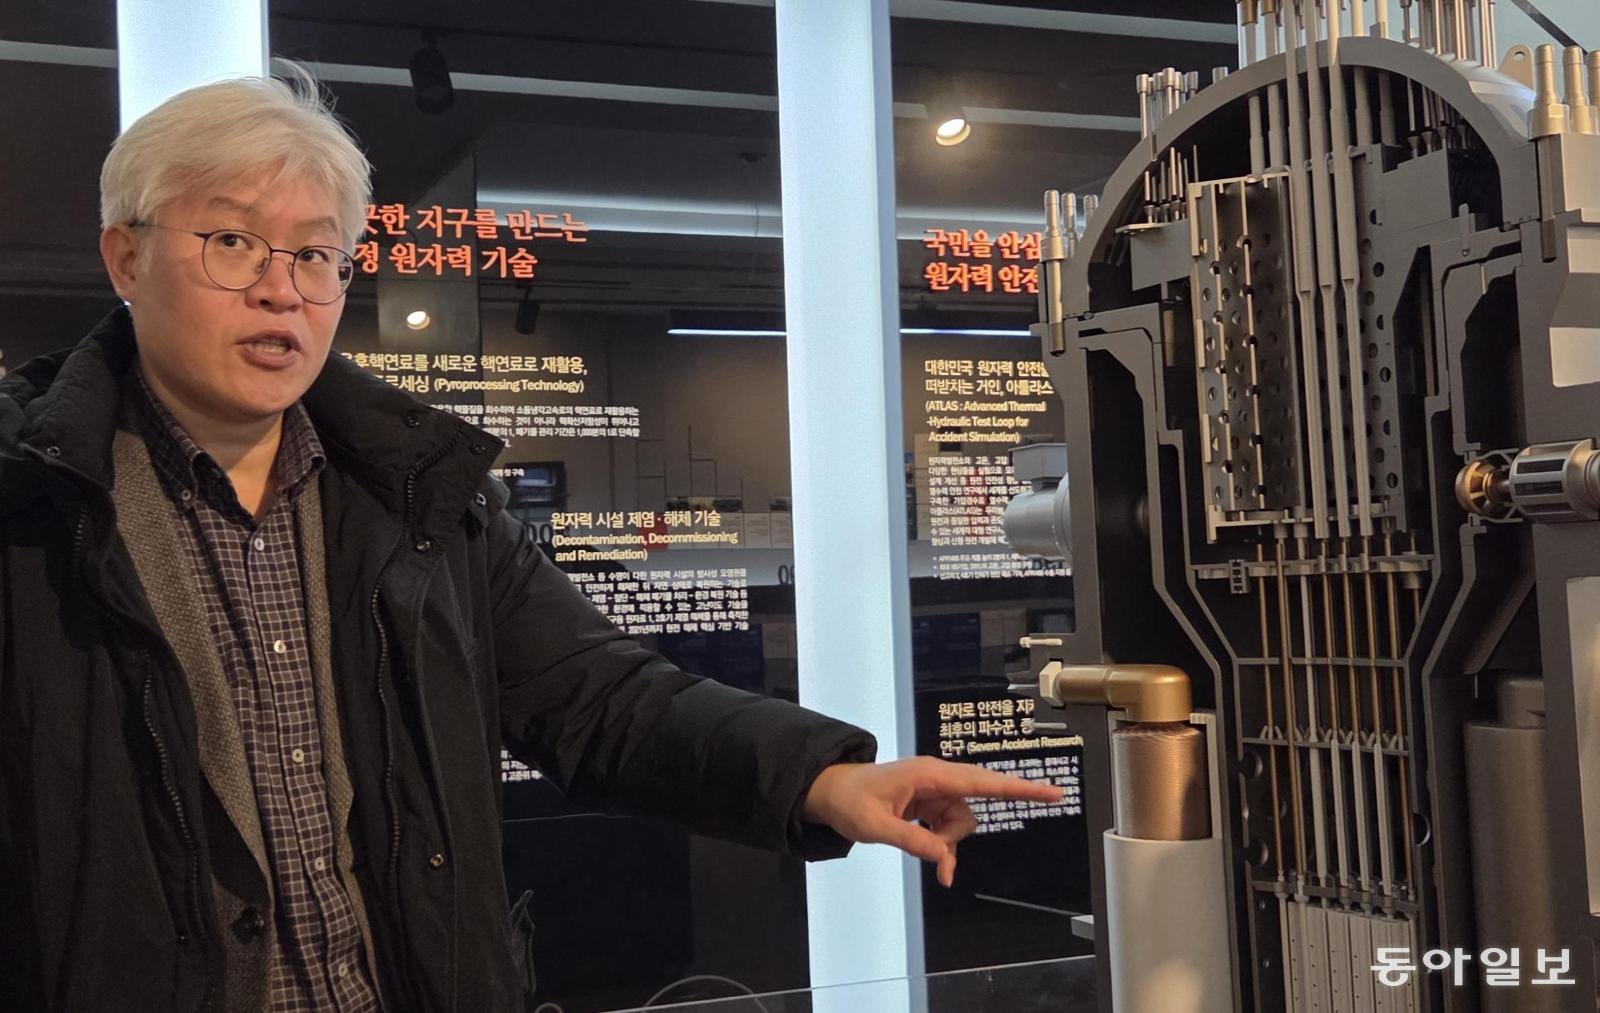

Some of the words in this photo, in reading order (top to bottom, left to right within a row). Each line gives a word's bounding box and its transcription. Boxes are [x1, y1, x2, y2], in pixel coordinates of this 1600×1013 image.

[416, 205, 498, 239] 지구를
[506, 209, 588, 242] 만드는
[923, 228, 995, 258] 국민을
[388, 242, 472, 277] 원자력
[481, 246, 538, 279] 기술
[924, 262, 993, 293] 원자력
[432, 354, 477, 372] 새로운
[480, 355, 539, 373] 핵연료로
[541, 356, 588, 376] 재활용,
[924, 359, 974, 377] 대한민국
[977, 360, 1014, 377] 원자력
[434, 378, 521, 393] (Pyroprocessing
[521, 379, 585, 393] Technology)
[925, 379, 974, 395] 떠받치는
[976, 380, 1005, 397] 거인,
[1006, 380, 1054, 396] 아틀라스
[485, 405, 515, 415] 회수하여
[925, 400, 958, 413] (ATLAS
[963, 400, 1008, 412] Advanced
[1008, 401, 1047, 412] Thermal
[483, 416, 512, 425] 회수하는
[515, 416, 531, 426] 것이
[534, 417, 556, 426] 아니라
[926, 415, 972, 429] -Hydraulic
[972, 415, 991, 427] Test
[992, 416, 1014, 429] Loop
[1015, 416, 1029, 427] for
[929, 431, 968, 443] Accident
[968, 431, 1021, 444] Simulation)
[550, 511, 593, 530] 원자력
[595, 511, 624, 529] 시설
[694, 510, 722, 527] 기술
[551, 533, 647, 549] (Decontamination,
[647, 531, 739, 545] Decommissioning
[555, 549, 577, 562] and
[577, 548, 648, 562] Remediation)
[597, 571, 606, 582] 등
[609, 570, 631, 582] 수명이
[632, 570, 648, 581] 다한
[650, 570, 671, 580] 원자력
[673, 569, 695, 579] 시설의
[696, 569, 718, 579] 방사성
[585, 582, 614, 593] 안전하게
[725, 589, 740, 599] 기술
[740, 589, 748, 599] 등
[664, 602, 674, 612] 수
[676, 601, 692, 612] 있는
[727, 599, 748, 610] 기술을
[625, 613, 648, 625] 원자로
[734, 620, 749, 631] 기술
[938, 702, 977, 721] 원자로
[977, 699, 1015, 718] 안전을
[939, 720, 977, 739] 최후의
[978, 718, 1018, 736] 파수꾼,
[940, 739, 966, 757] 연구
[966, 740, 1001, 754] (Severe
[1001, 738, 1040, 752] Accident
